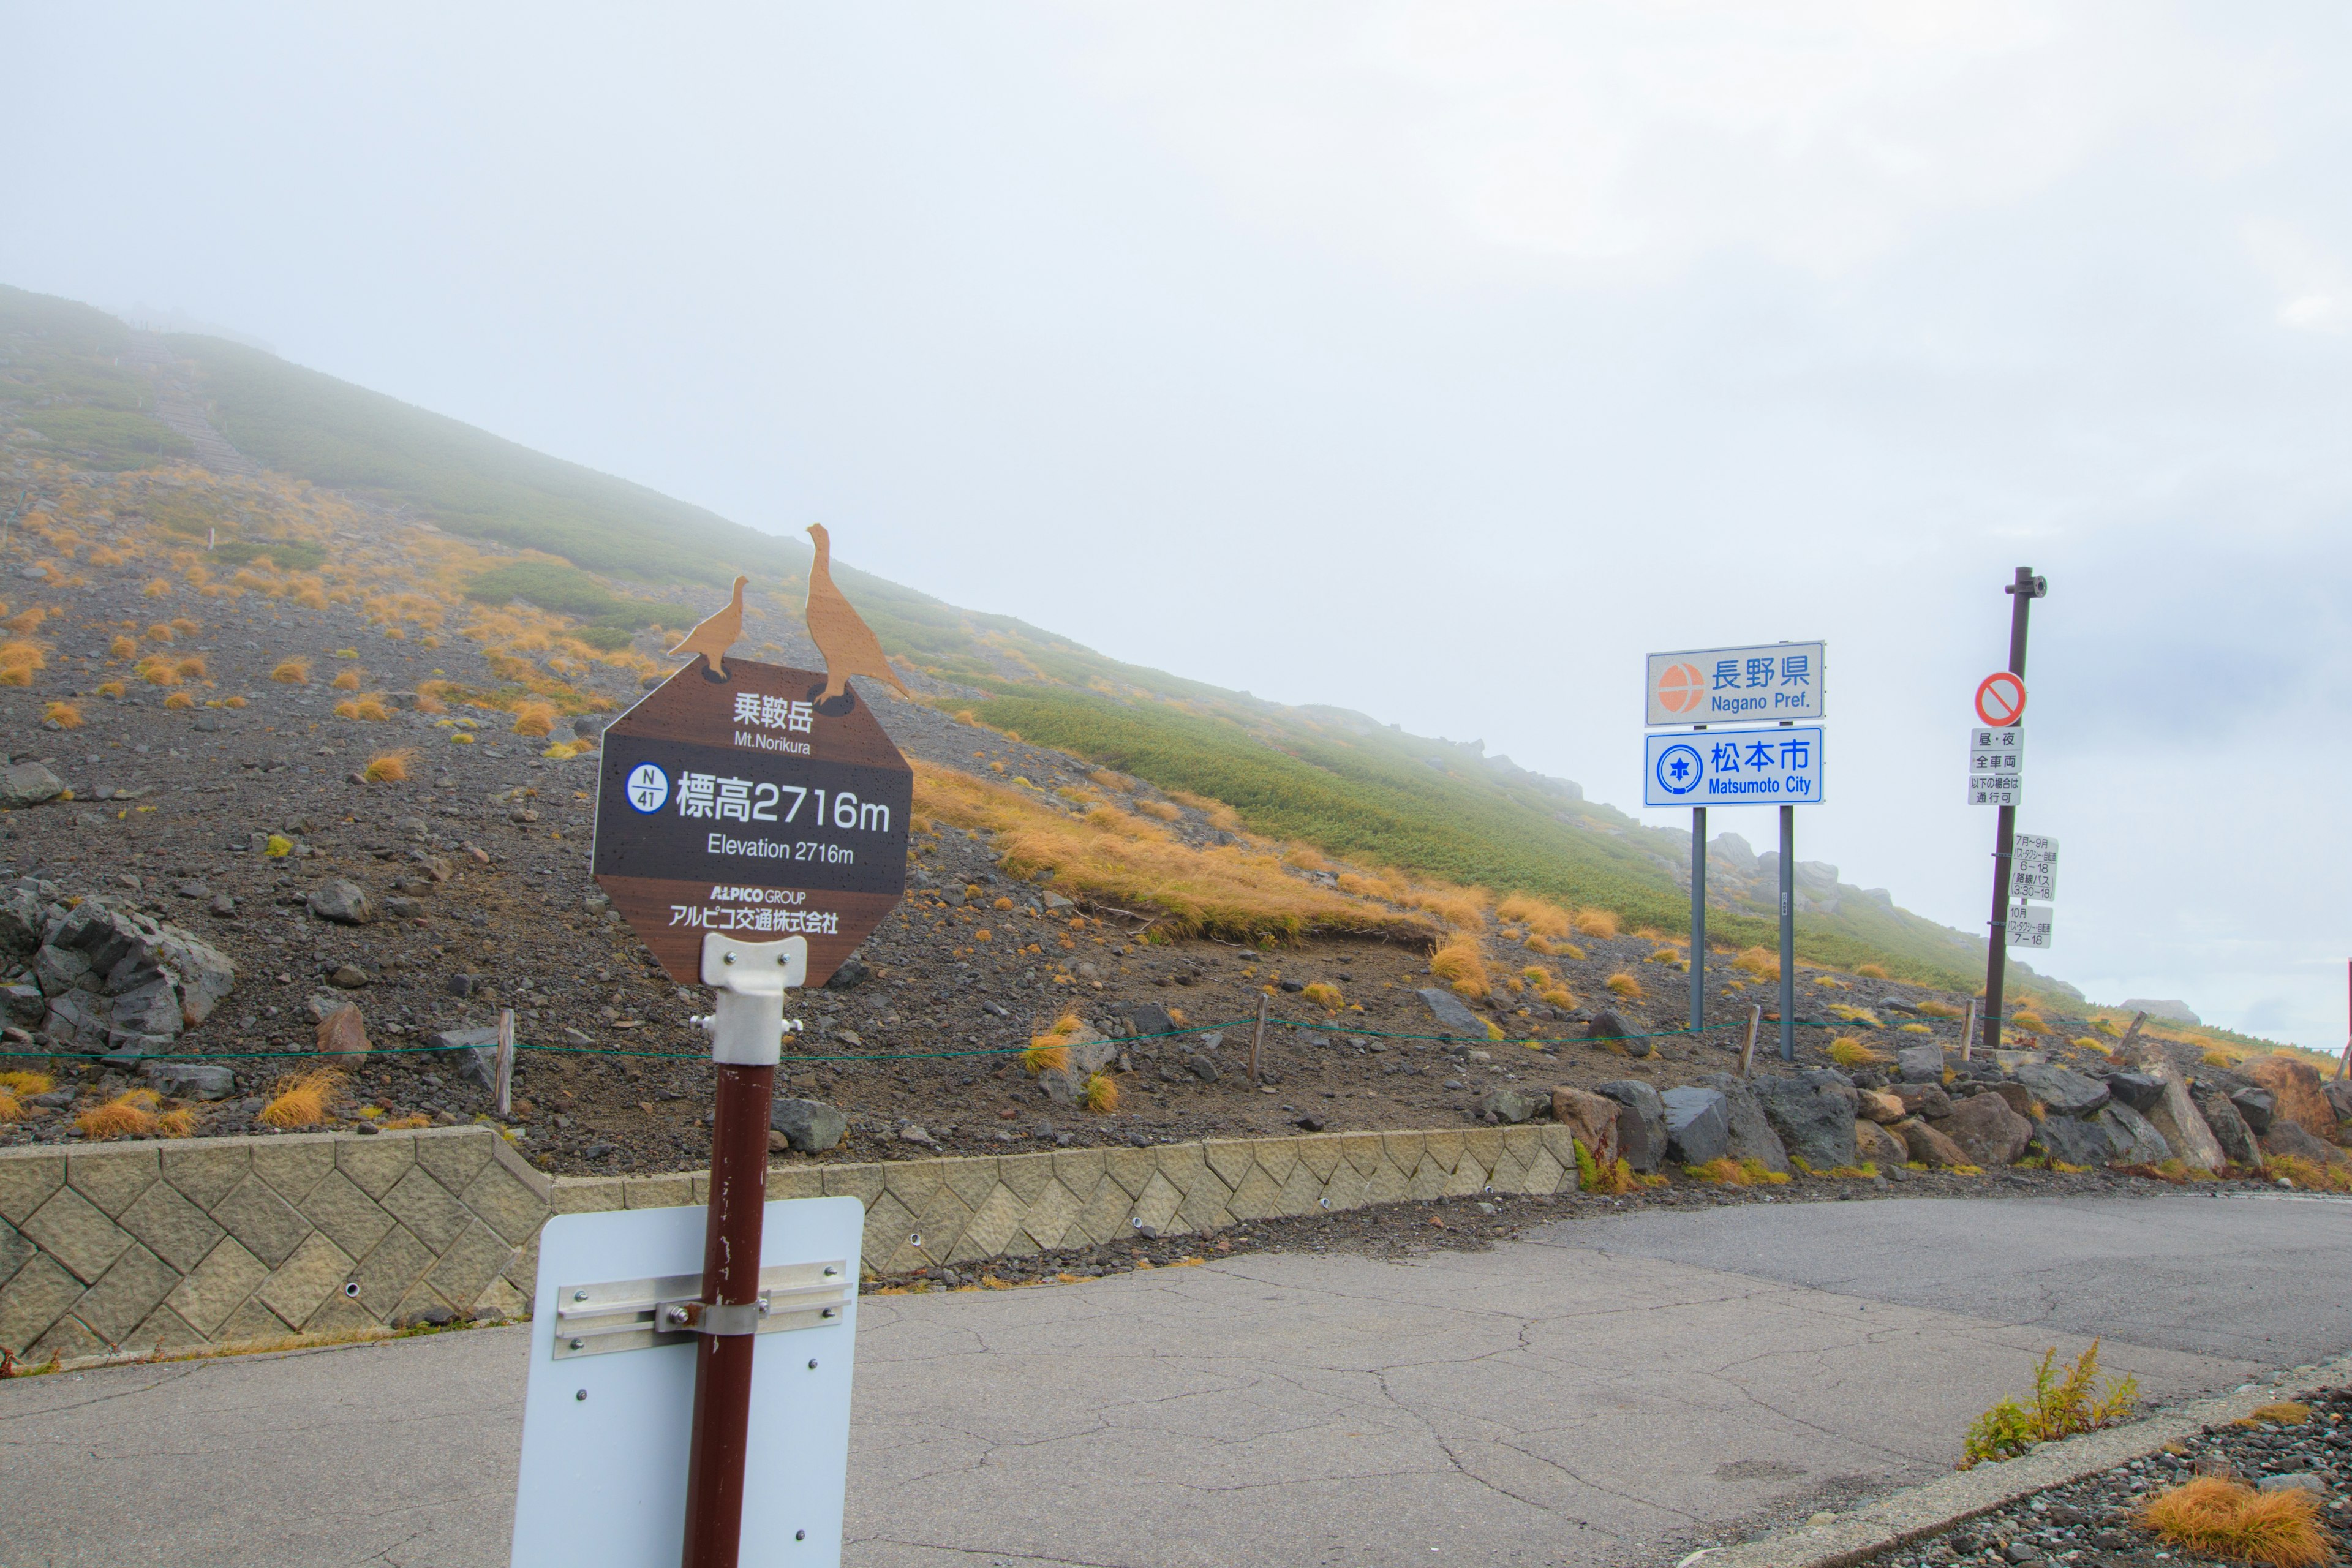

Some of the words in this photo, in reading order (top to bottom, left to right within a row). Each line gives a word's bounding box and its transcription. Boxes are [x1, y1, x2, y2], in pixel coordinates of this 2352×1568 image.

[1712, 655, 1810, 690] 長野県
[1711, 696, 1767, 714] Nagano
[1774, 691, 1810, 708] Pref.
[733, 692, 813, 734] 乗鞍岳
[734, 731, 811, 755] Mt.Norikura
[1979, 733, 2015, 746] 昼・夜
[1711, 739, 1811, 773] 松本市
[1976, 755, 2016, 768] 全車両
[643, 769, 655, 784] N
[1709, 777, 1779, 794] Matsumoto
[1785, 775, 1811, 795] City
[1971, 778, 2019, 789] 以下の場合は
[637, 791, 654, 807] 41
[676, 771, 890, 832] 標高2716m
[1977, 792, 2011, 803] 通行可
[707, 833, 790, 859] Elevation
[795, 841, 854, 864] 2716m
[710, 886, 764, 902] ALPICO
[764, 889, 806, 905] GROUP
[669, 905, 839, 934] アルピコ交通株式会社
[2010, 907, 2026, 918] 10月
